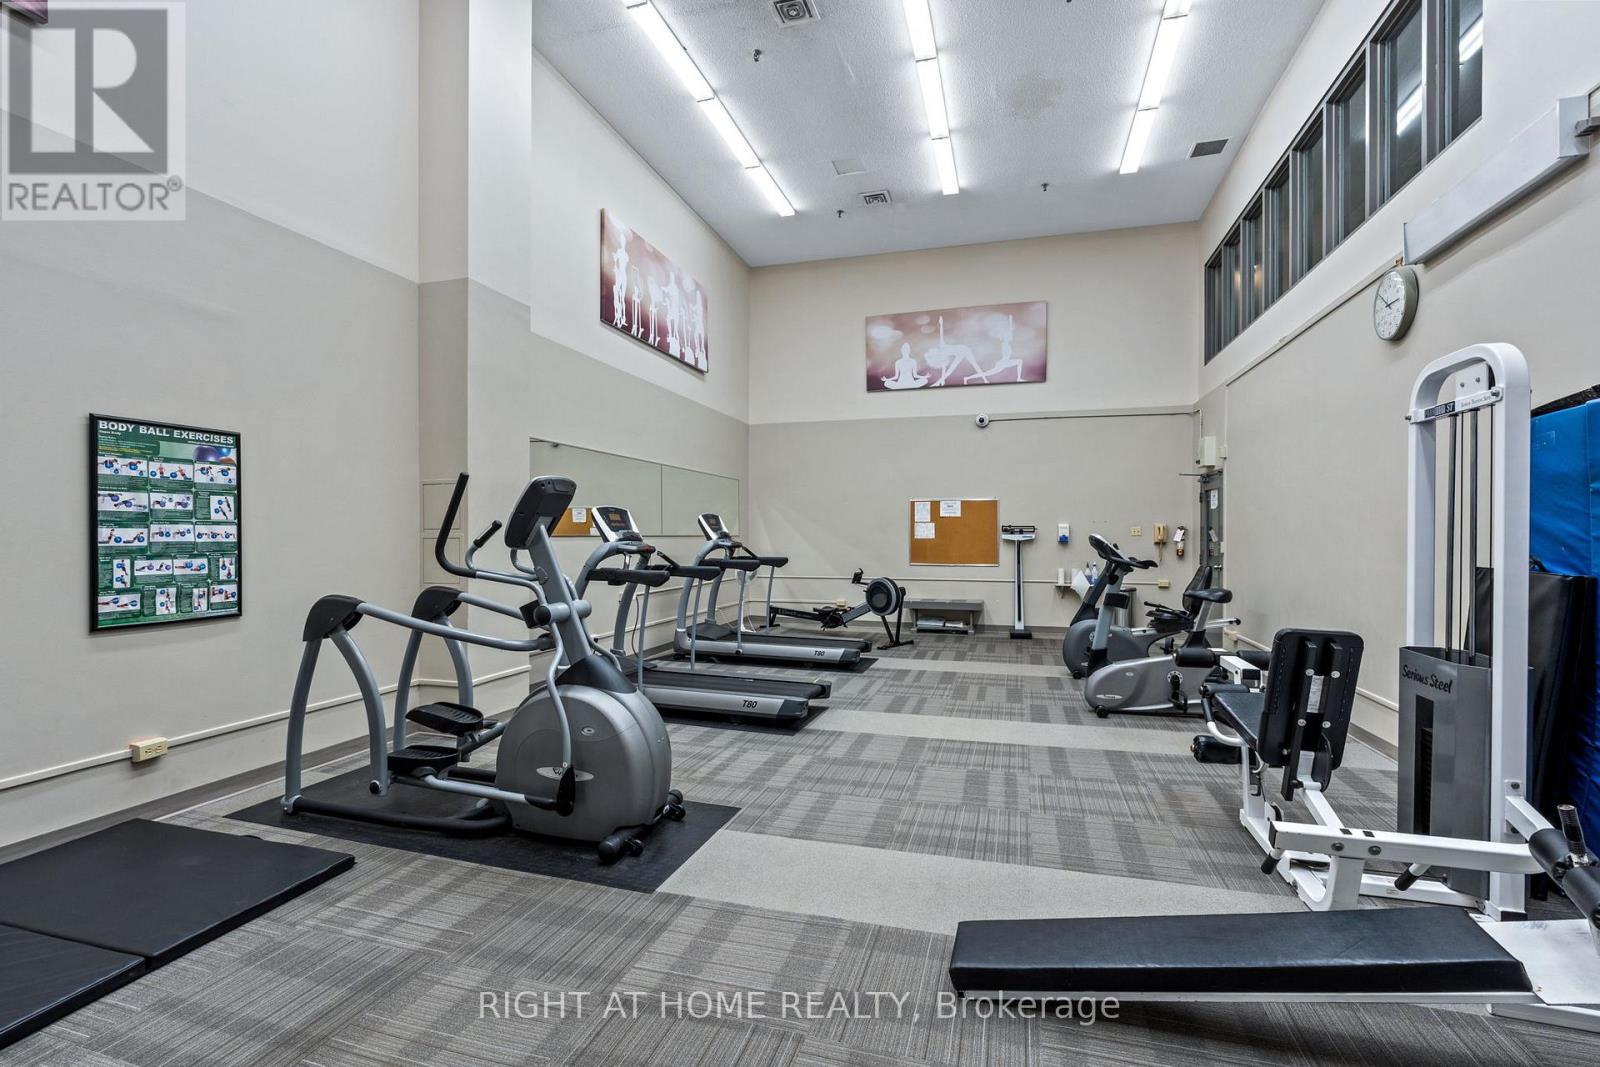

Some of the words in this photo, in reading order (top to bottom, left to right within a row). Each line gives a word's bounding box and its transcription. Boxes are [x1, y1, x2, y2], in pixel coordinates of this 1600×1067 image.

[99, 420, 136, 432] BODY
[140, 425, 170, 437] BALL
[173, 430, 234, 444] EXERCISES
[1402, 664, 1428, 685] Serious
[1429, 673, 1452, 693] Steel
[742, 700, 757, 708] T80
